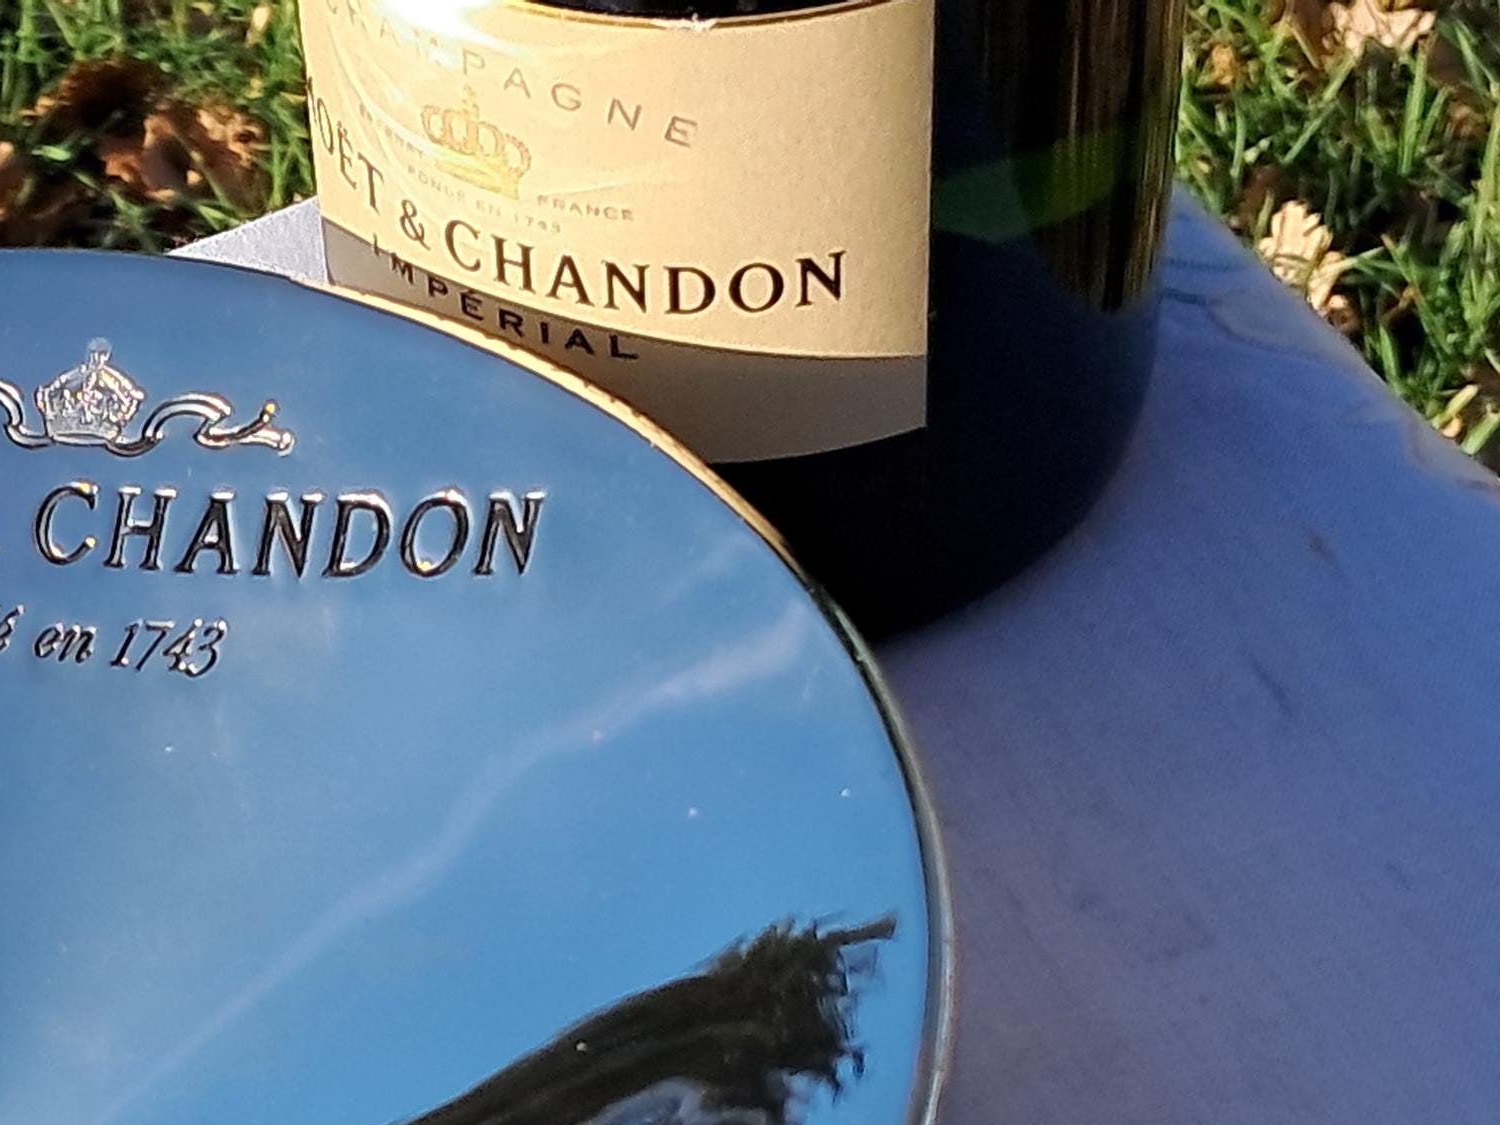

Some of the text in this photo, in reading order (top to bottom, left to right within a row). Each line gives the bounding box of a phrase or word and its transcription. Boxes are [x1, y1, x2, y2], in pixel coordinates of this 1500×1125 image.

[537, 194, 635, 222] FRANCE
[372, 232, 640, 361] IMPÉRIAL
[400, 200, 431, 251] &
[444, 218, 847, 316] CHANDON
[35, 480, 547, 578] CHANDON
[34, 621, 97, 664] en
[110, 617, 229, 678] 1743
